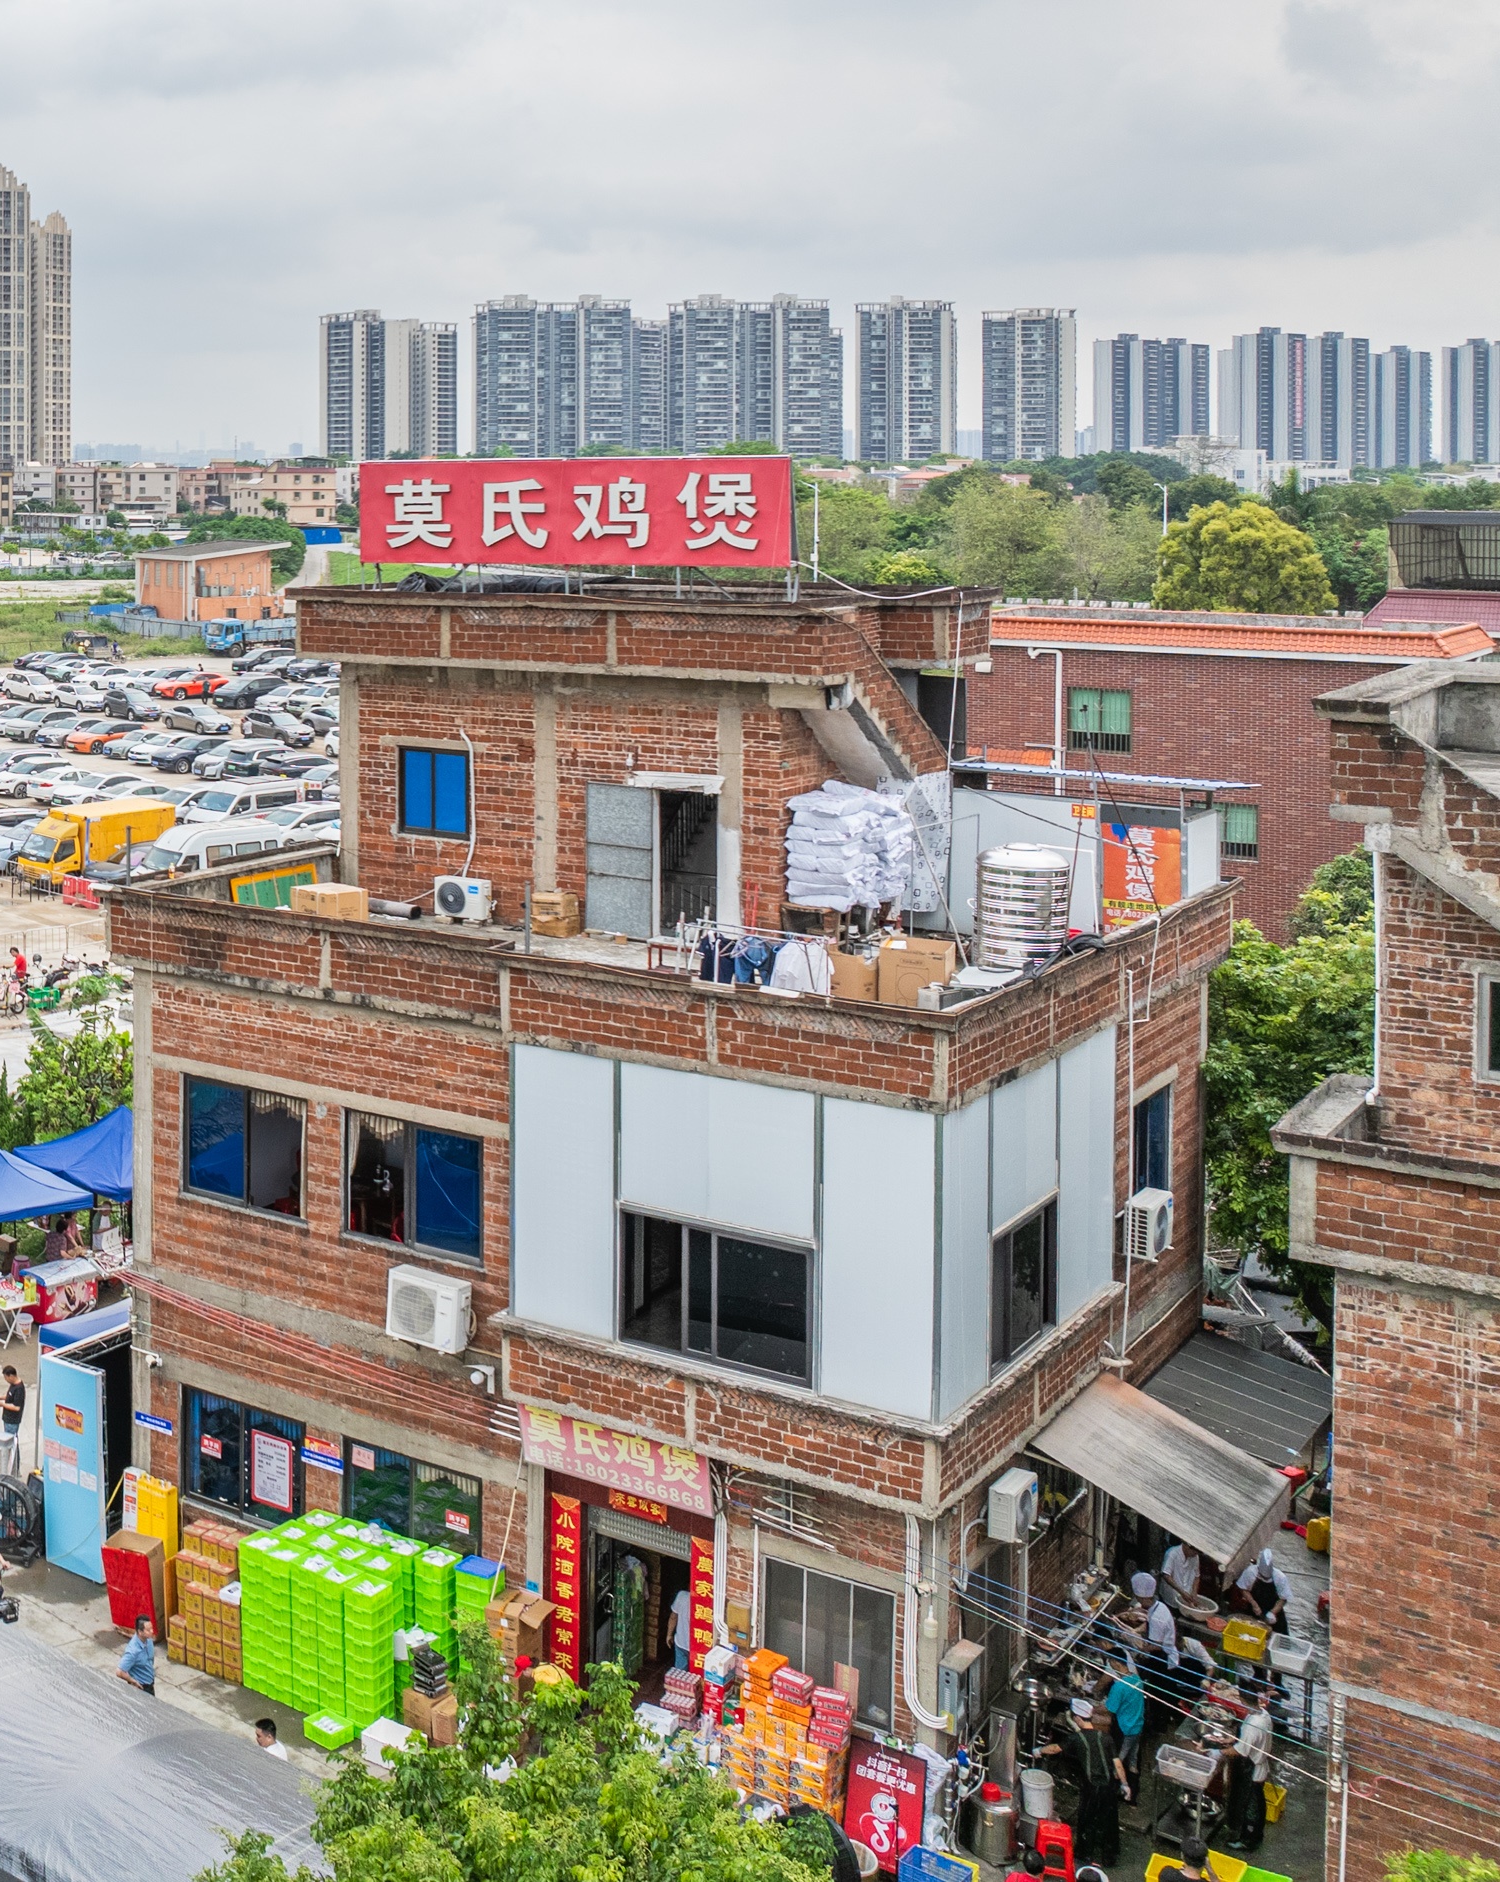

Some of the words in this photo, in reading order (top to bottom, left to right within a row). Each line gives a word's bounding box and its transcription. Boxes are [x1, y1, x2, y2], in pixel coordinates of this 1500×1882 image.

[385, 472, 761, 550] 莫氏鸡煲
[1072, 806, 1095, 818] 卫生间
[1125, 827, 1156, 902] 莫氏鸡煲
[524, 1404, 703, 1491] 莫氏鸡煲
[866, 1755, 908, 1780] 抖音扫码
